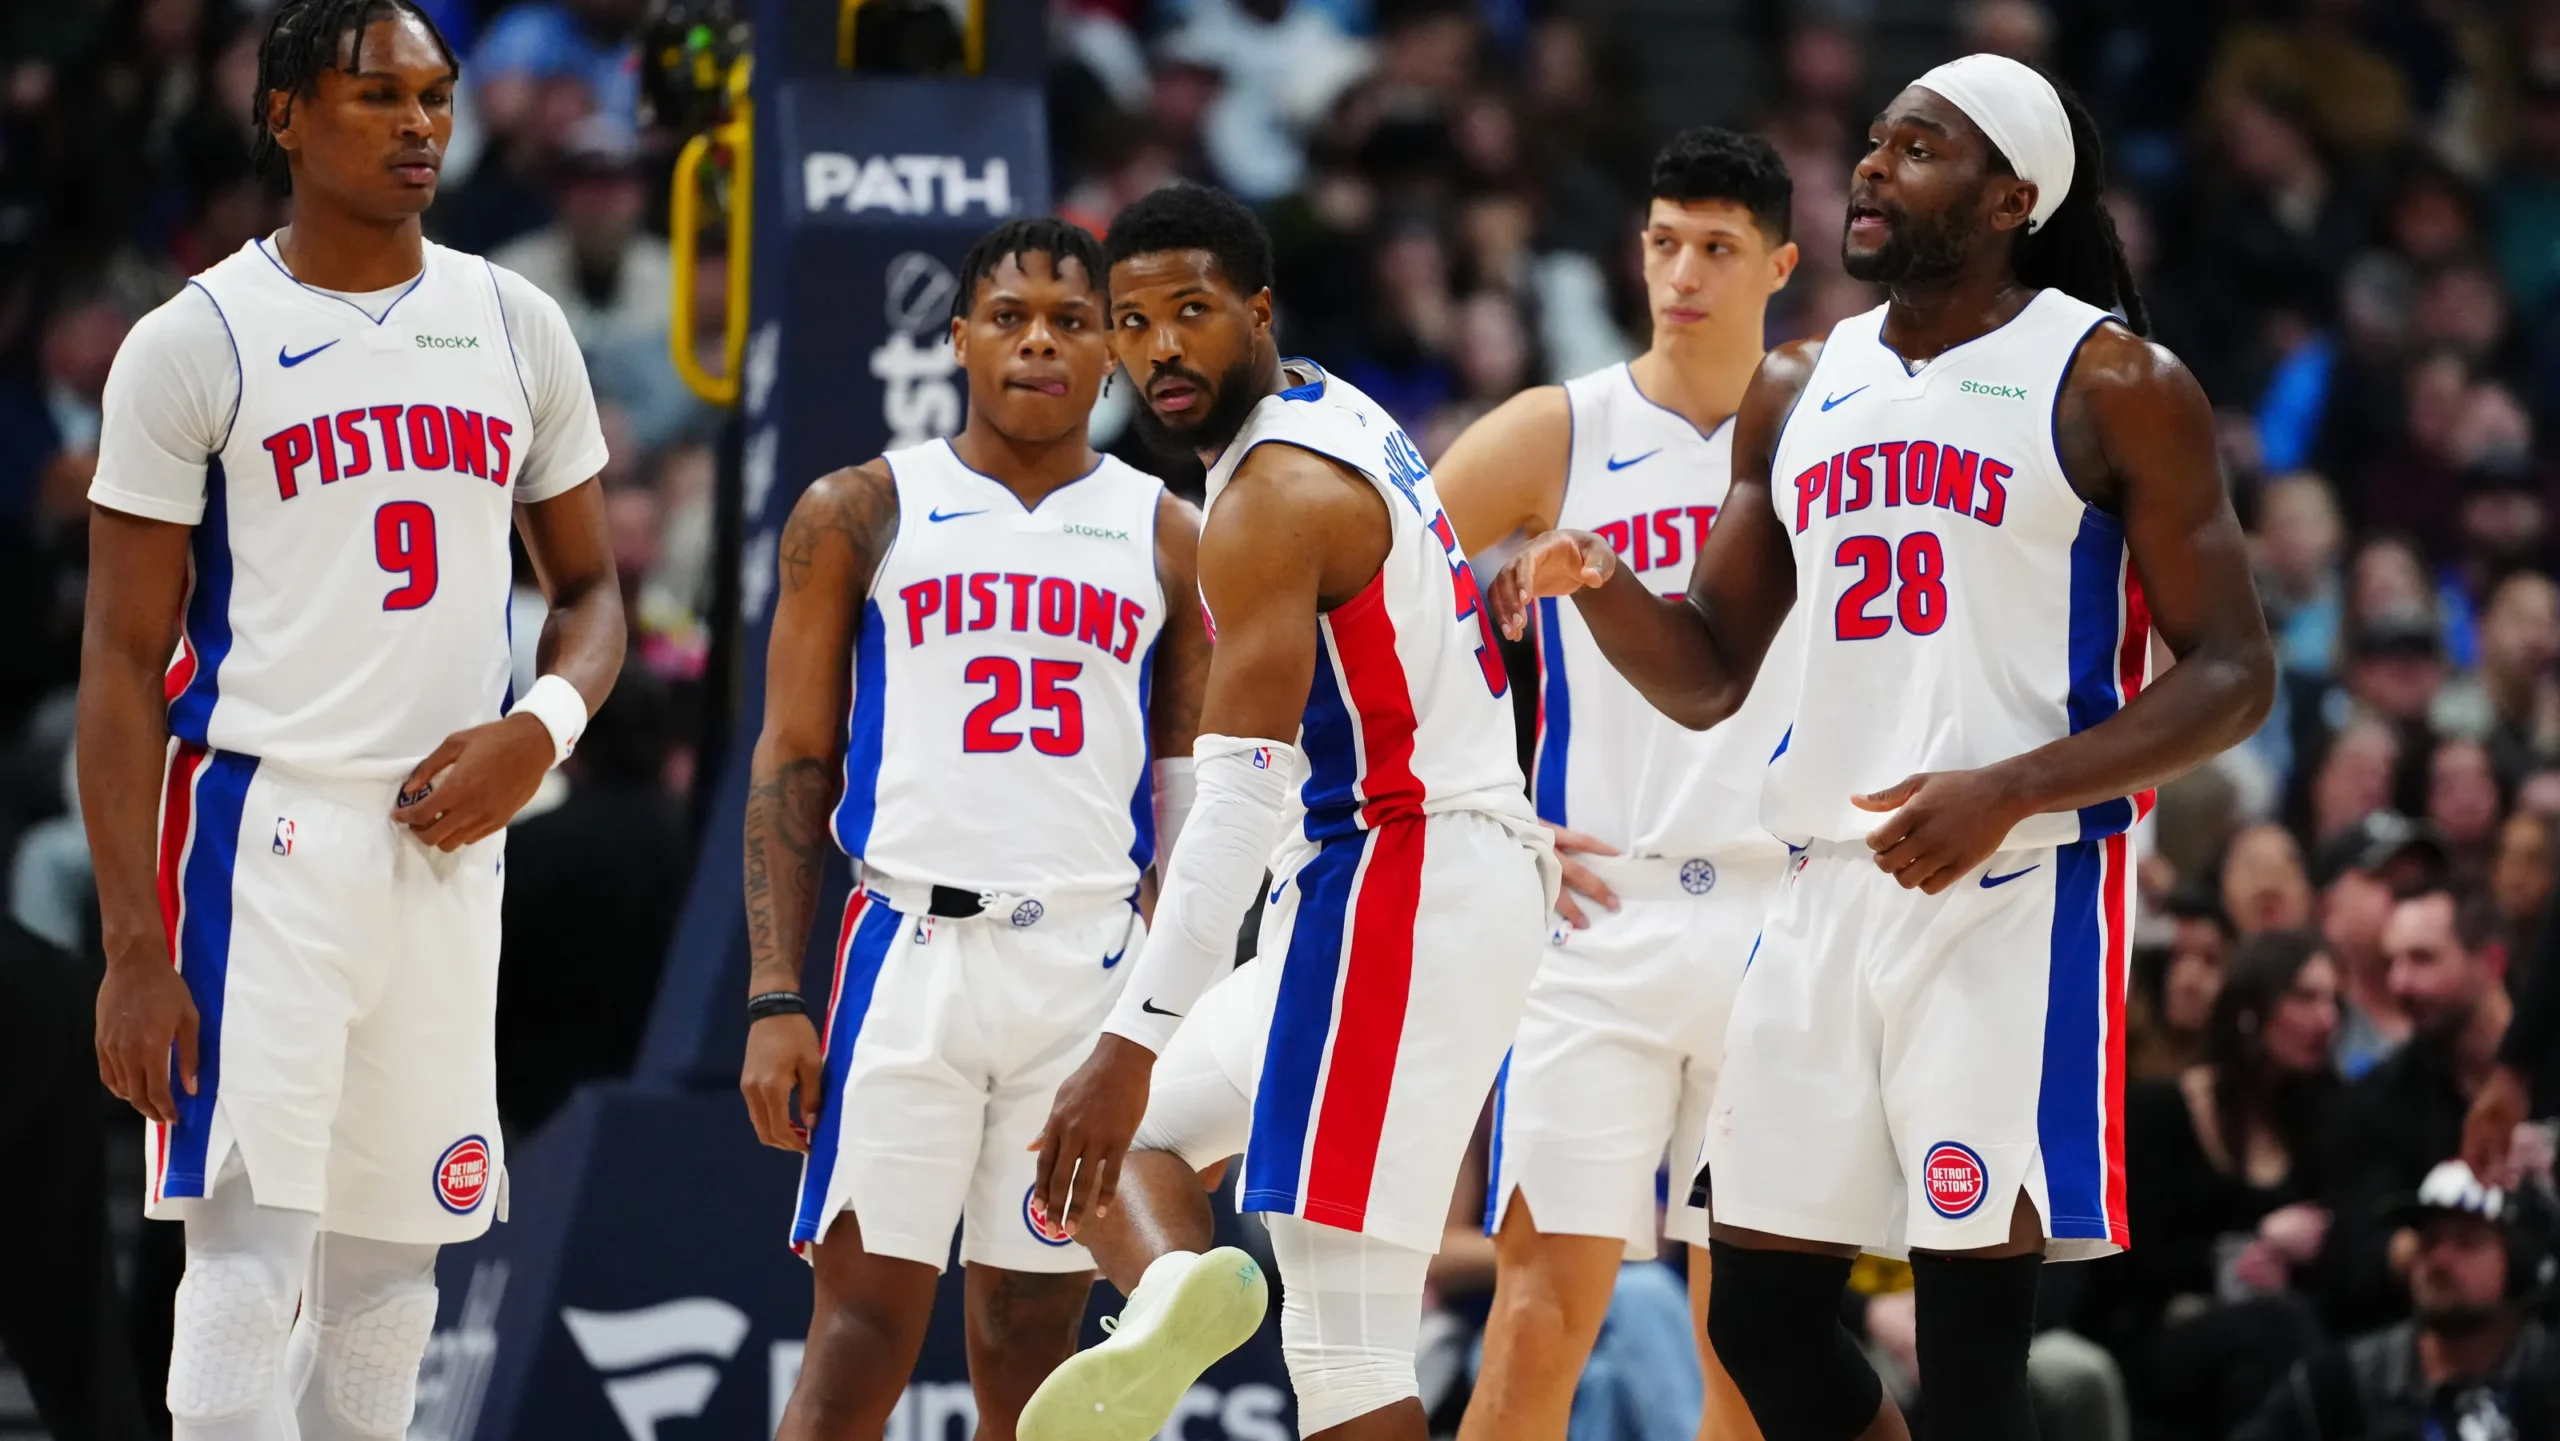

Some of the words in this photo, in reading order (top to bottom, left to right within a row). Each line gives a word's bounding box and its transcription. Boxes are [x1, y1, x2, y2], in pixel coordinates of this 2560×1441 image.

[803, 152, 1010, 217] PATH
[415, 334, 480, 349] StockX
[1960, 380, 2028, 401] StockX
[263, 404, 513, 501] PISTONS
[1794, 440, 2014, 536] PISTONS
[374, 501, 439, 612] 9
[1591, 505, 1718, 574] PIST
[900, 572, 1145, 665] PISTONS
[1834, 531, 1948, 641] 28
[963, 656, 1084, 757] 25
[448, 1173, 483, 1189] PISTONS
[449, 1159, 484, 1175] DETROIT
[1932, 1167, 1972, 1180] DETROIT
[1932, 1180, 1974, 1193] PISTONS
